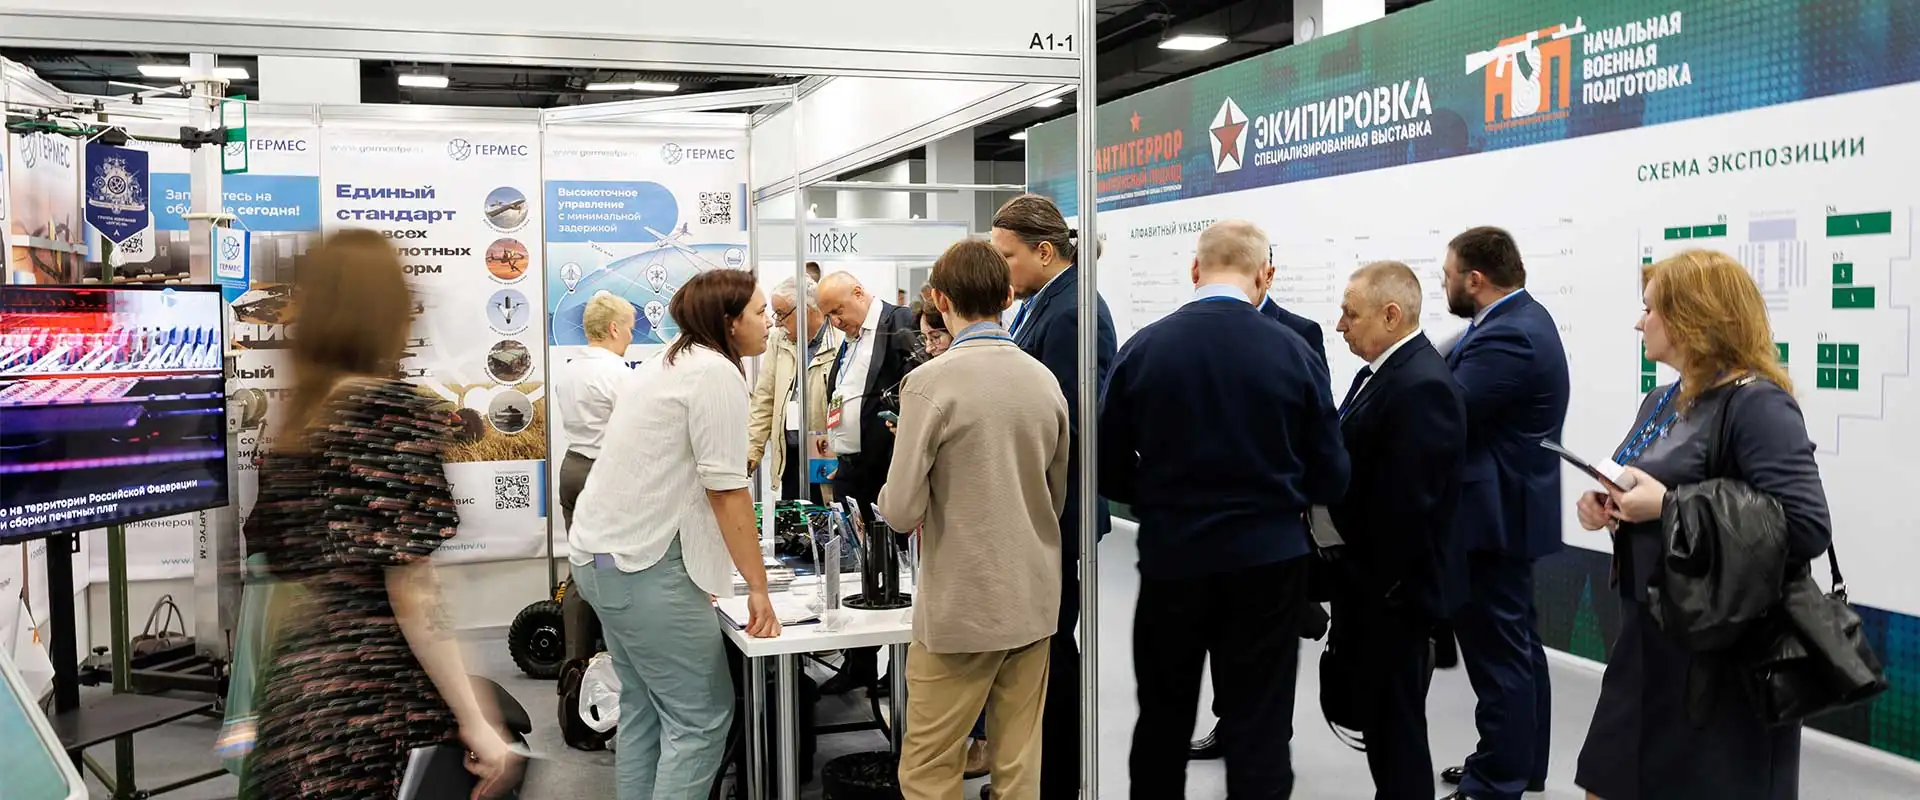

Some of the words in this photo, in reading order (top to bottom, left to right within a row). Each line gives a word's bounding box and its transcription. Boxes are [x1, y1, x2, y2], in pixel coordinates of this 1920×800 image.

[1583, 11, 1682, 55] НАЧАЛЬНАЯ
[1029, 33, 1073, 51] A1-1
[1583, 44, 1657, 80] ВОЕННАЯ
[1583, 62, 1692, 104] ПОДГОТОВКА
[1254, 76, 1432, 149] ЭКИПИРОВКА
[249, 139, 307, 152] ГЕРМЕС
[475, 144, 528, 156] ГЕРМЕС
[1254, 134, 1369, 167] СПЕЦИАЛИЗИРОВАННАЯ
[1371, 120, 1432, 146] ВЫСТАВКА
[686, 148, 736, 160] ГЕРМЕС
[1637, 158, 1700, 182] СХЕМА
[1707, 136, 1865, 175] ЭКСПОЗИЦИИ
[255, 192, 272, 202] на
[336, 184, 436, 200] Единый
[558, 187, 639, 198] Высокоточное
[238, 205, 300, 217] сегодня!
[558, 200, 625, 210] управление
[336, 208, 457, 224] стандарт
[567, 211, 642, 221] минимальной
[558, 223, 618, 234] задержкой
[1130, 221, 1178, 239] АЛФАВИТНЫЙ
[10, 508, 23, 517] на
[25, 499, 87, 514] территории
[89, 486, 146, 503] Российской
[147, 479, 198, 494] Федерации
[9, 515, 47, 529] сборки
[49, 508, 95, 521] печатных
[96, 503, 118, 514] плат
